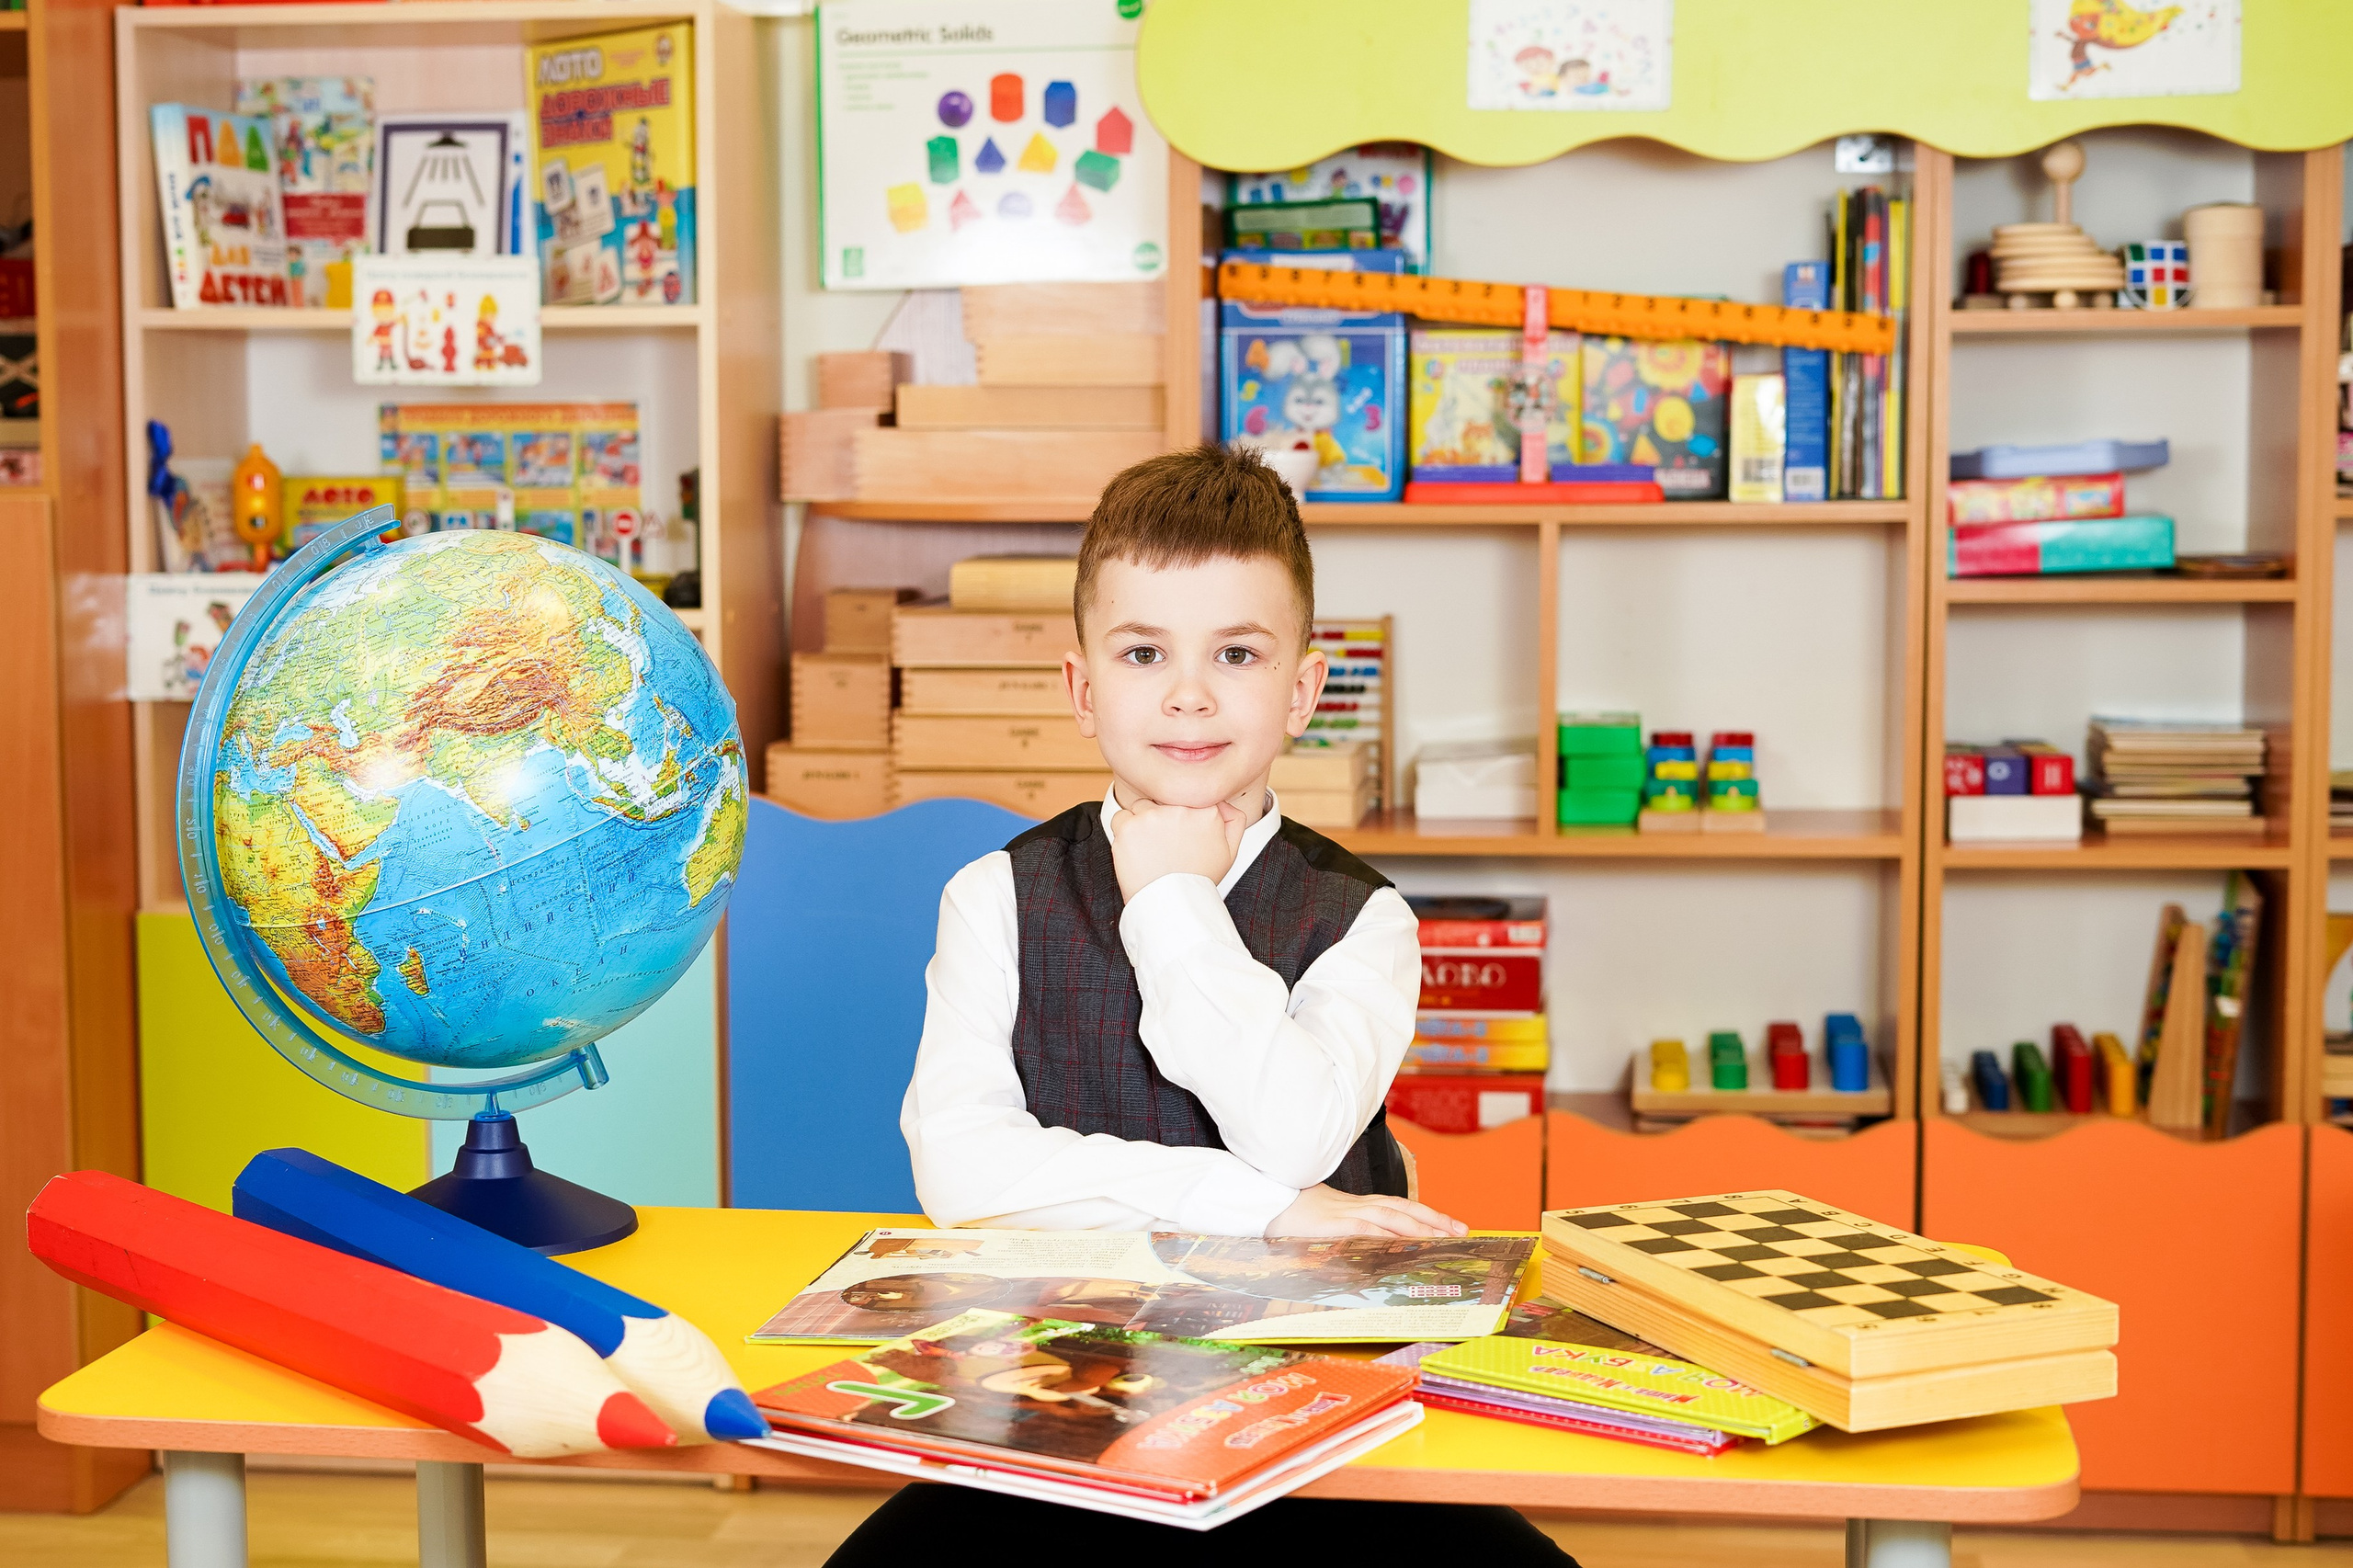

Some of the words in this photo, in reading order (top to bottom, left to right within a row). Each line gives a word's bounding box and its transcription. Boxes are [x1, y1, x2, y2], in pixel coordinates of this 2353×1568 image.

[835, 25, 932, 46] Geometric
[939, 23, 995, 44] Solids
[302, 486, 375, 506] ЛОТО
[1531, 1345, 1686, 1377] АЗБУКА
[1225, 1371, 1318, 1404] МОЯ
